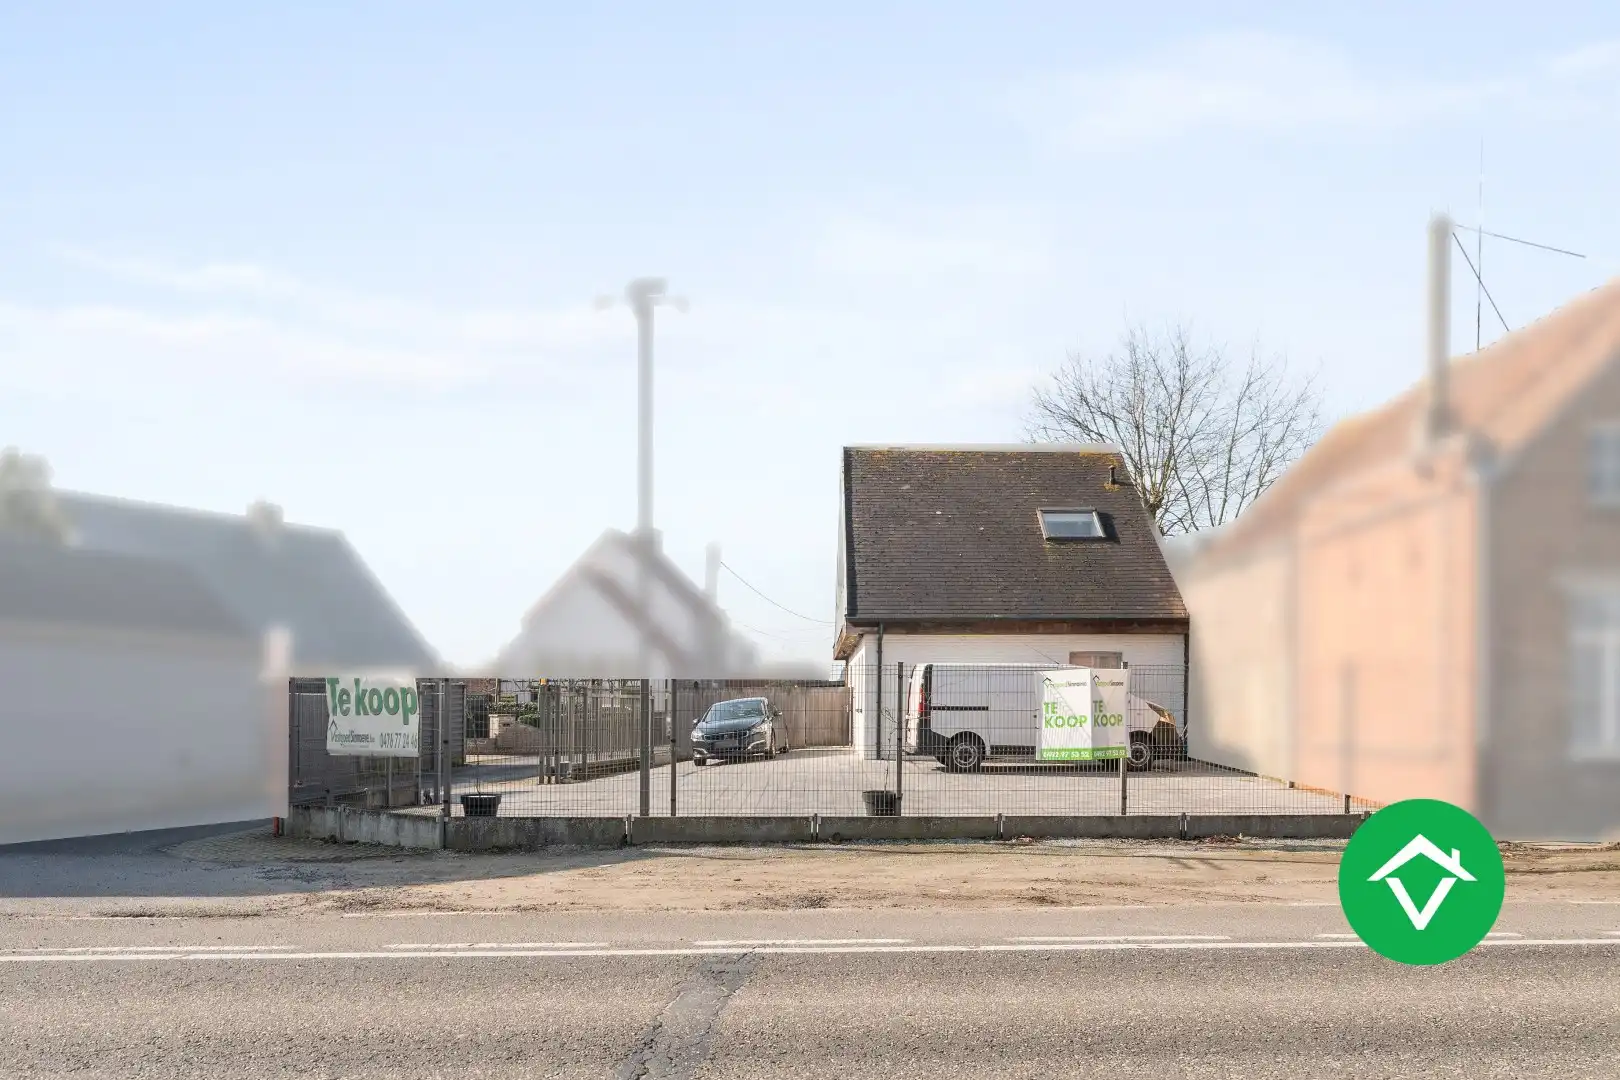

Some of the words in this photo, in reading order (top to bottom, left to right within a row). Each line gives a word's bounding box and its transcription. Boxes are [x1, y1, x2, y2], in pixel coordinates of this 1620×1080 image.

[326, 678, 351, 716] Te
[354, 678, 418, 725] koop
[1043, 702, 1058, 714] TE
[1093, 700, 1103, 713] TE
[1044, 715, 1088, 728] KOOP
[1093, 714, 1123, 727] KOOP
[394, 732, 401, 748] 77
